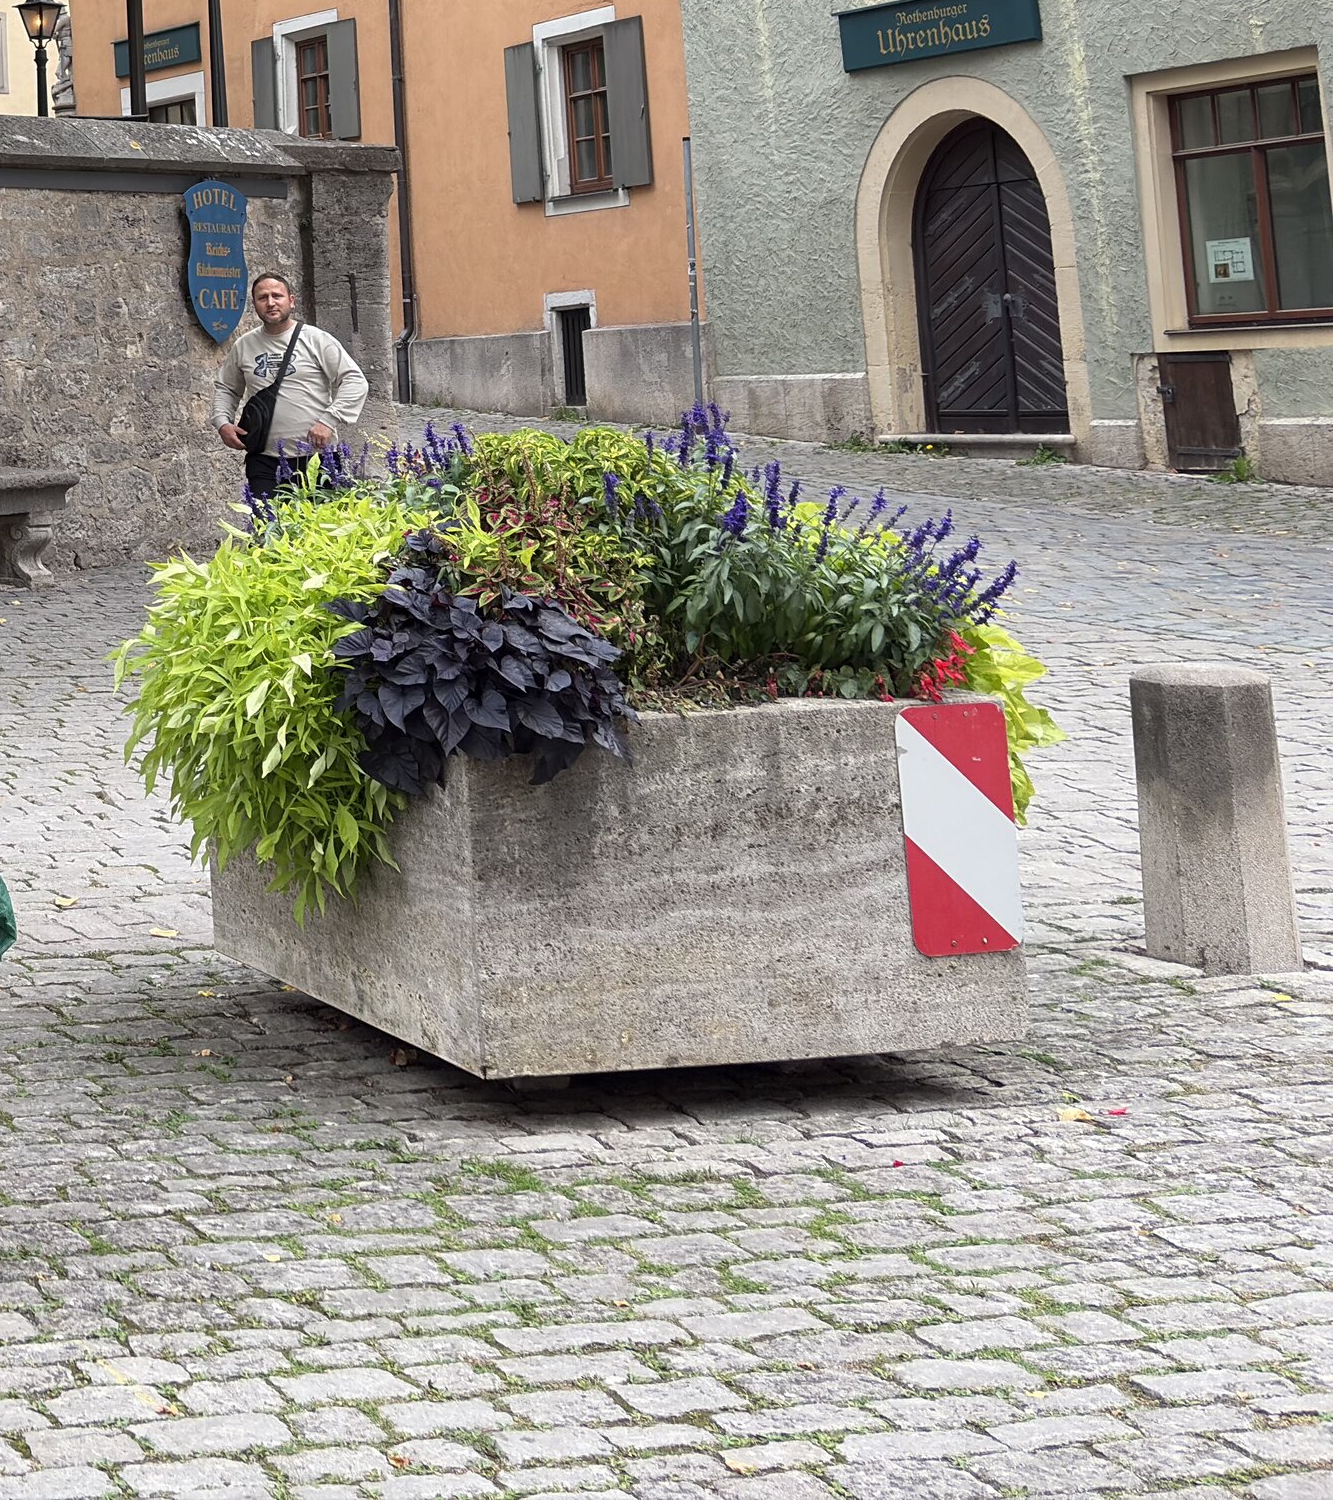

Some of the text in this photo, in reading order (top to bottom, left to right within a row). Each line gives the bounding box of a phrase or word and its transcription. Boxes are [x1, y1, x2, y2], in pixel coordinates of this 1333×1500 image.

[895, 3, 968, 27] Rothenburger
[877, 14, 991, 57] Uhrenhaus
[144, 44, 180, 66] renhaus
[193, 188, 237, 211] HOTEL
[193, 221, 241, 235] RESTAURANT
[199, 284, 240, 310] CAFÉ
